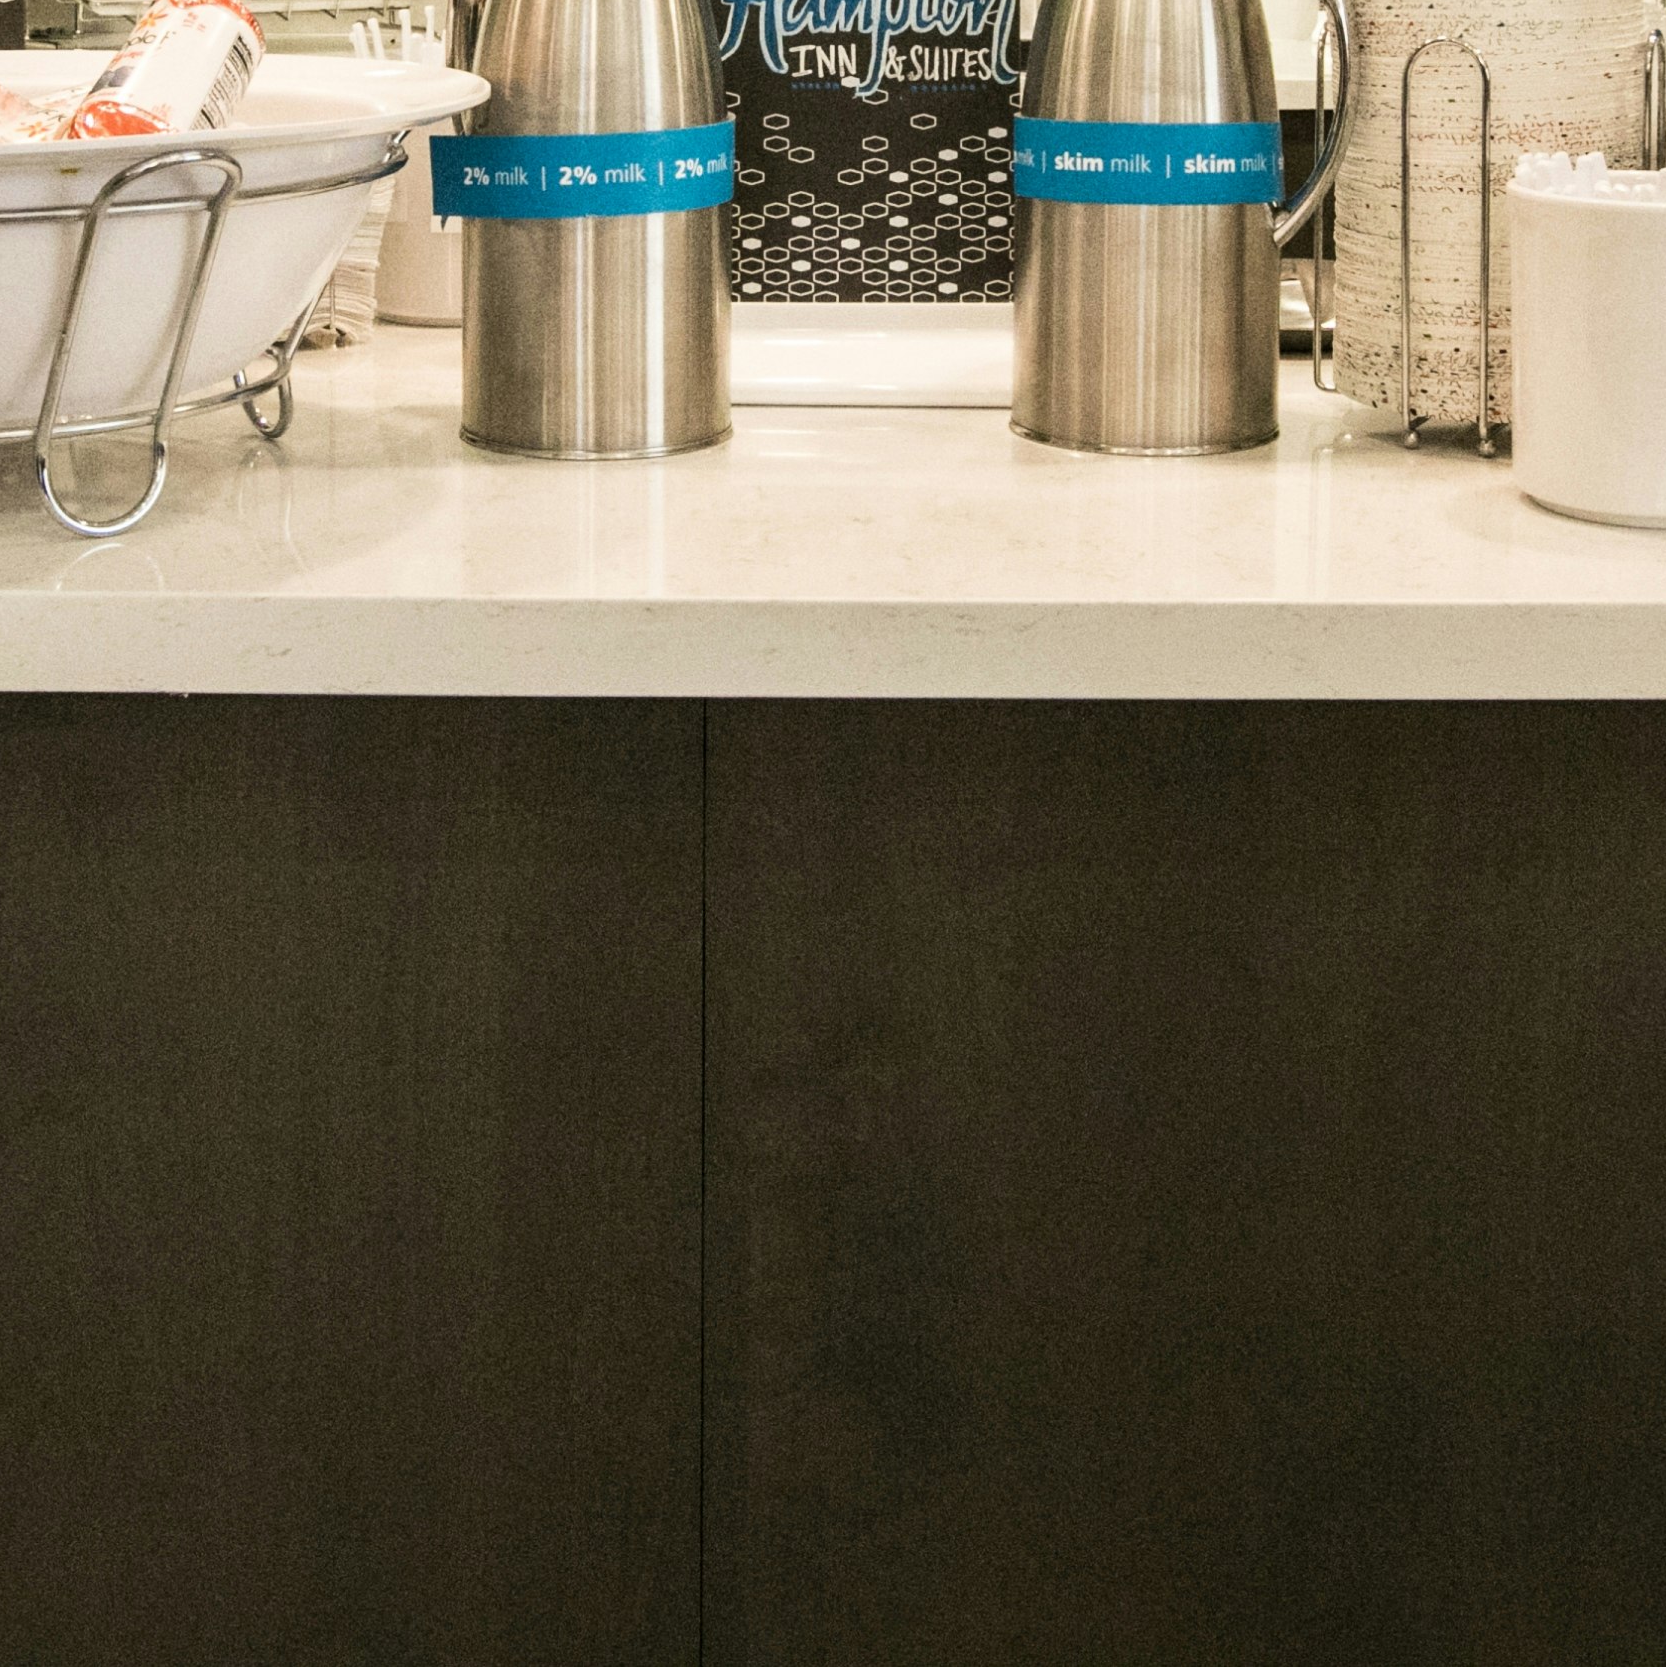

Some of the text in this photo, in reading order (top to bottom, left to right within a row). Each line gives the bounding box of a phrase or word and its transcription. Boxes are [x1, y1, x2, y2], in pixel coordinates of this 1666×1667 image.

[789, 44, 858, 79] INN
[463, 152, 728, 186] 2% milk 2% milk 2% milk
[1054, 151, 1104, 173] skim
[1110, 153, 1152, 174] milk
[1184, 153, 1236, 174] skim
[1240, 153, 1268, 173] milk
